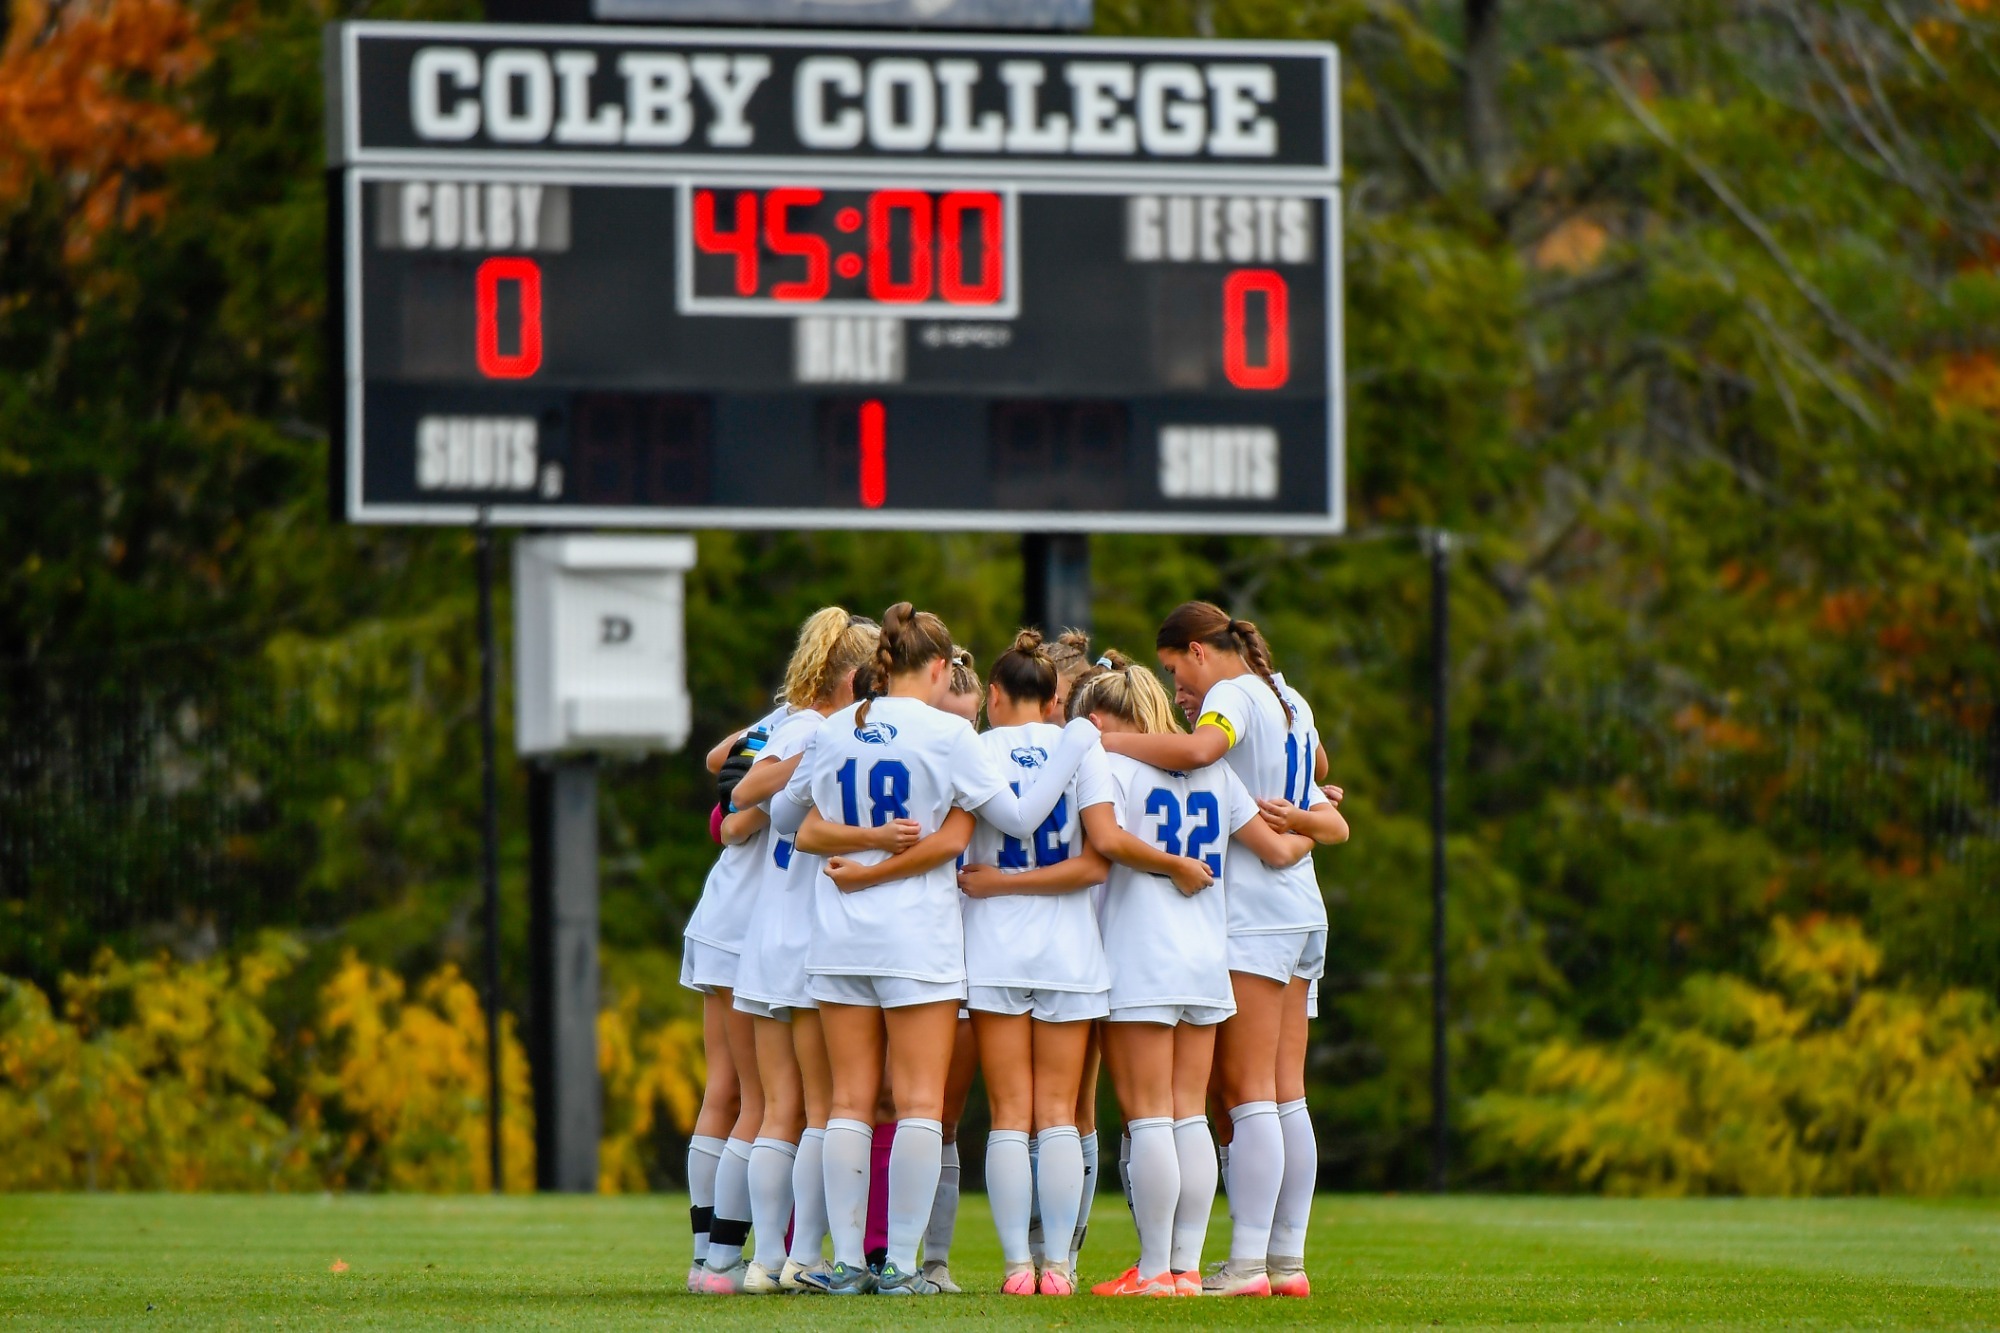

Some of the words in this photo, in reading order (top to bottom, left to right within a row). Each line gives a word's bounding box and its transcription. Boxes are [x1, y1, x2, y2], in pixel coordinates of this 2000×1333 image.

[410, 46, 772, 146] COLBY
[793, 56, 1278, 157] COLLEGE
[402, 182, 543, 251] COLBY
[693, 186, 1004, 305] 45:00
[1128, 195, 1311, 264] GUESTS
[475, 257, 543, 380] 0
[798, 317, 903, 382] HALF
[1222, 268, 1290, 390] 0
[416, 415, 538, 490] SHOTS
[859, 400, 886, 508] 1
[1159, 425, 1279, 499] SHOTS
[836, 756, 911, 828] 18
[1284, 732, 1313, 812] 11
[1144, 785, 1222, 879] 32
